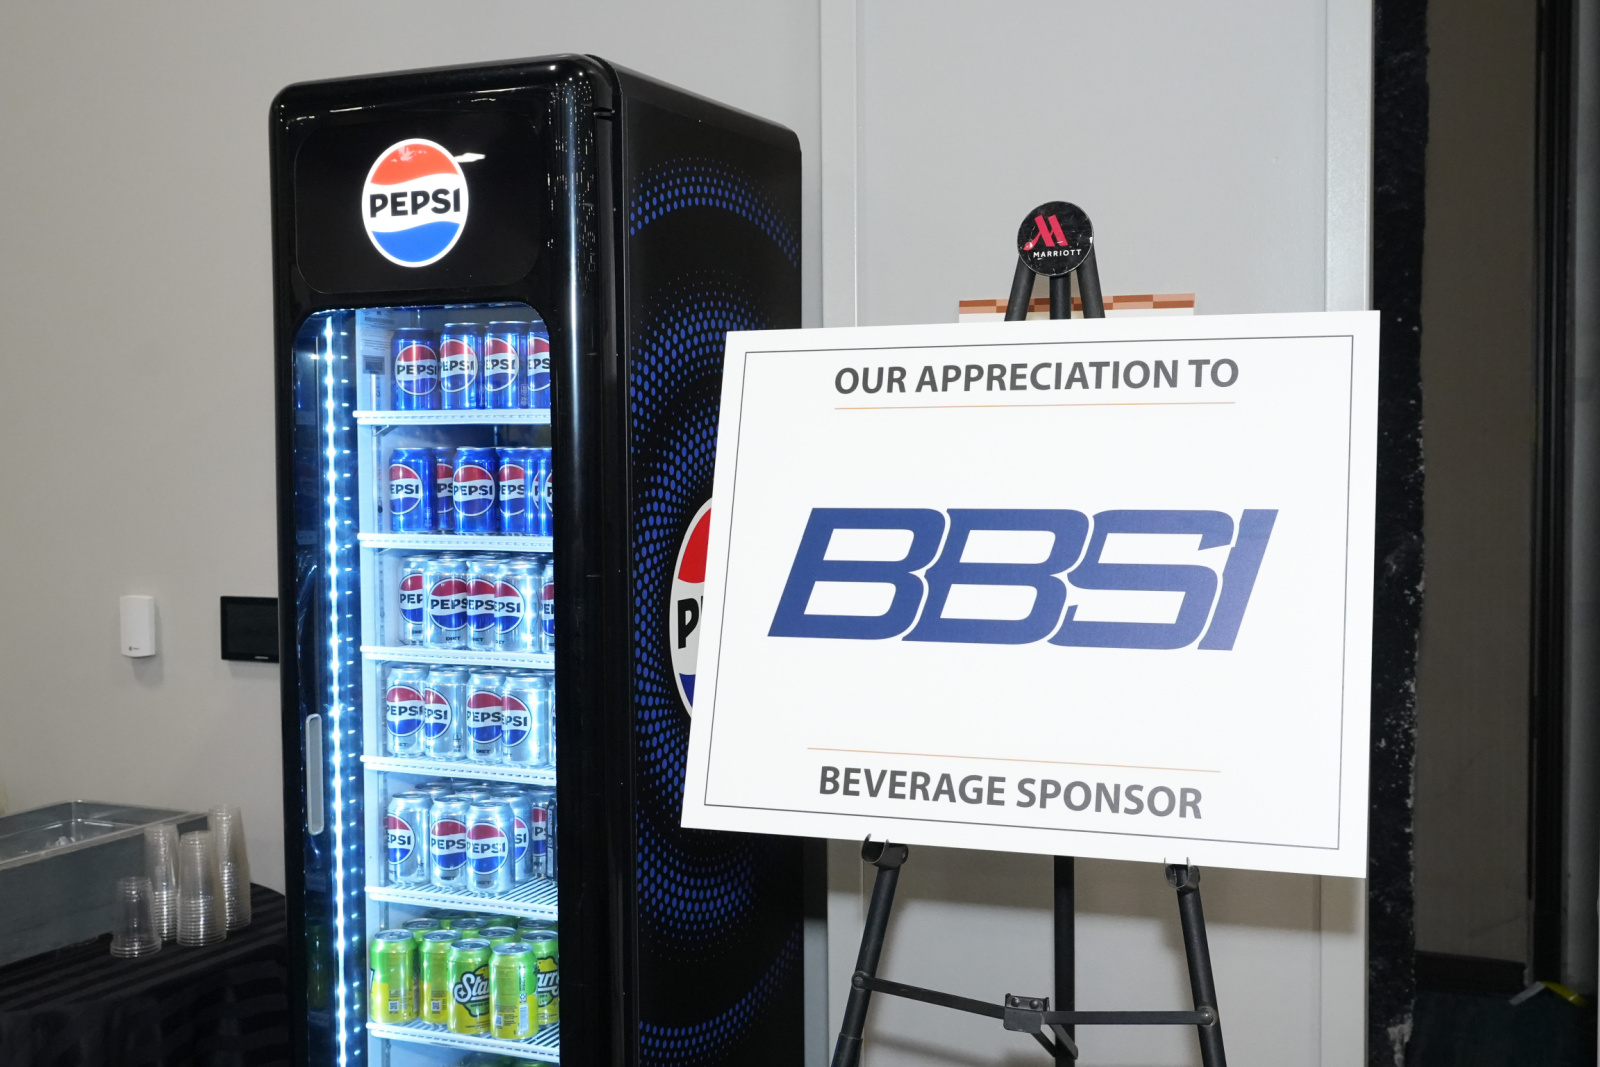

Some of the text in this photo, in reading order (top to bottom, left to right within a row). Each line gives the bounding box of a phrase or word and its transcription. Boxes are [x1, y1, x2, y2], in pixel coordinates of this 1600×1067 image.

[370, 188, 460, 218] PEPSI
[1033, 248, 1082, 259] MARRIOTT
[397, 364, 437, 375] PEPSI
[440, 360, 474, 372] EPSI
[486, 358, 516, 370] EPSI
[834, 357, 1240, 395] OUR APPRECIATION TO
[390, 483, 420, 495] EPSI
[453, 485, 493, 496] PEPSI
[500, 484, 525, 496] EPS
[767, 507, 1279, 651] BBSI
[399, 593, 423, 604] PEP
[430, 598, 467, 610] PEPS
[468, 599, 494, 611] EPS
[467, 711, 501, 723] PEPS
[818, 765, 1203, 820] BEVERAGE SPONSOR
[431, 838, 466, 850] PEPS
[467, 841, 506, 854] PEPSI
[453, 972, 489, 1003] Sta
